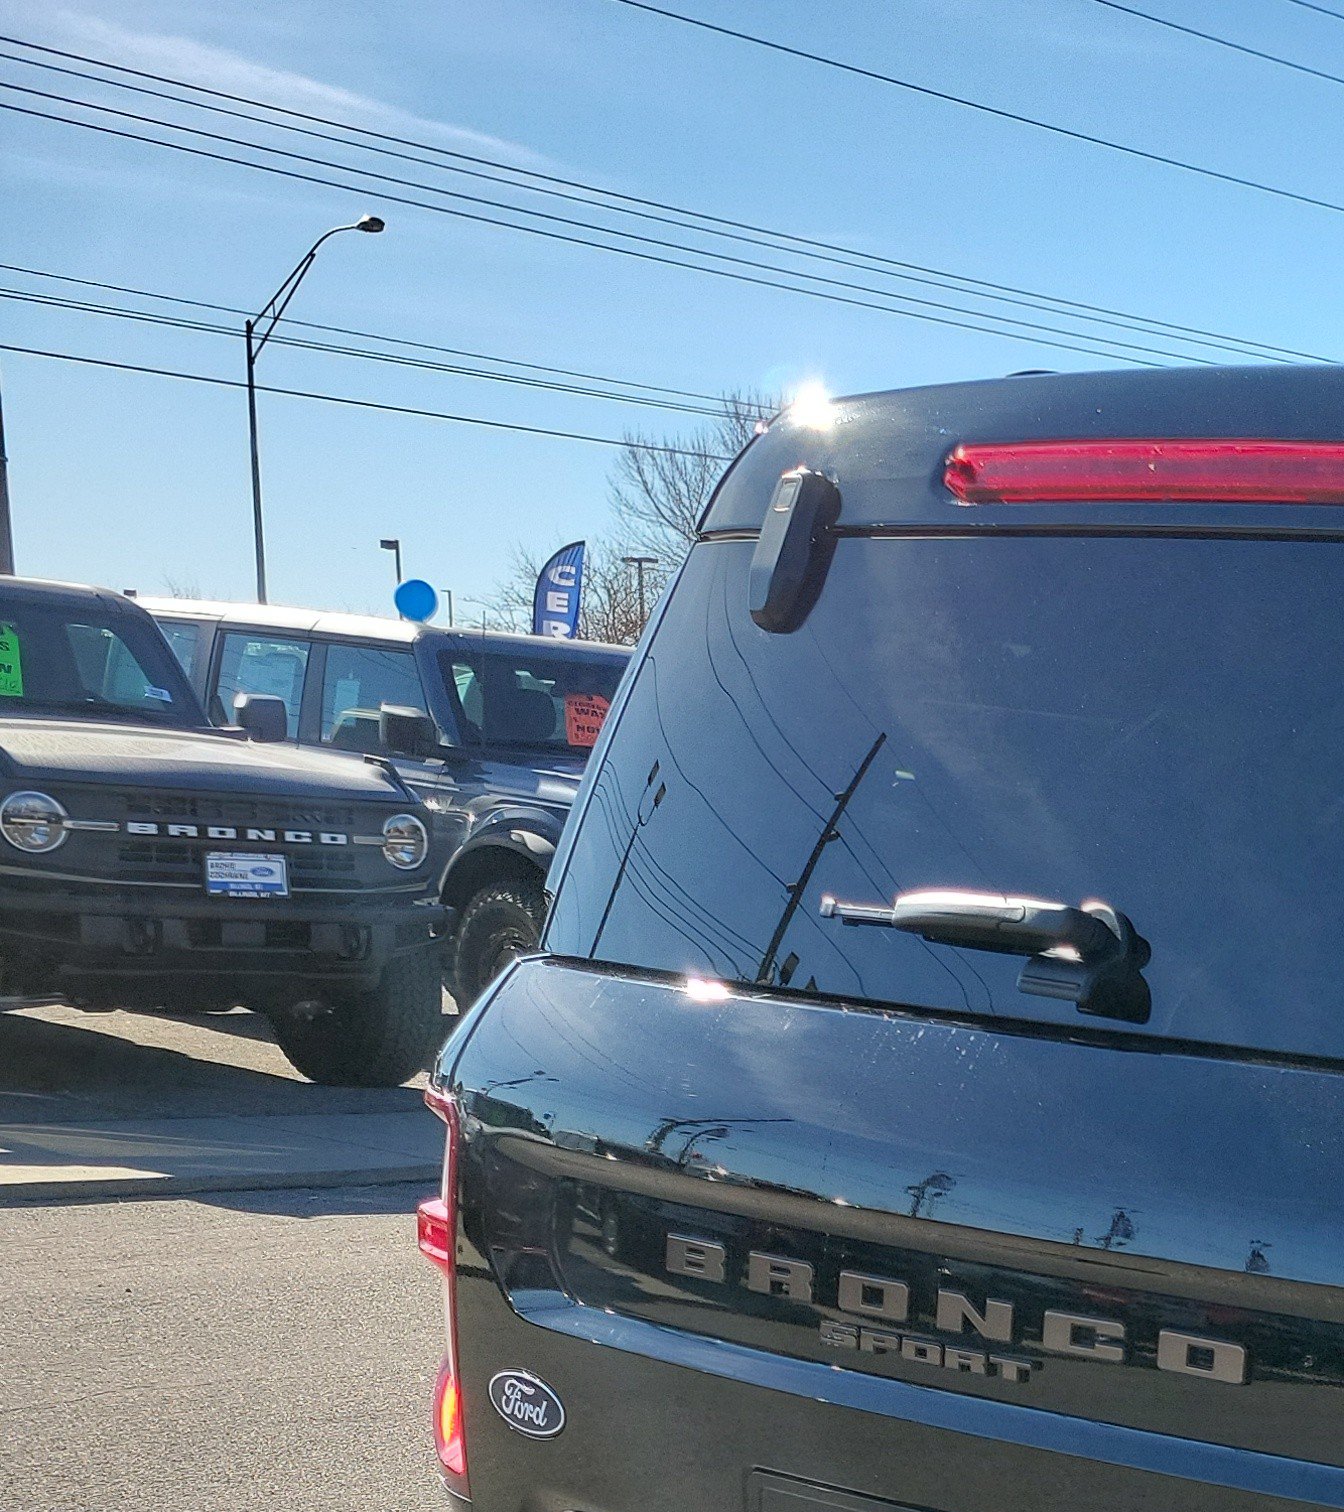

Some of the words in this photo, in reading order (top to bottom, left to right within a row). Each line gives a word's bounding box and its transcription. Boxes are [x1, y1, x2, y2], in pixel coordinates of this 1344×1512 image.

[126, 821, 348, 845] BRONCO
[666, 1232, 1250, 1385] BRONCO
[820, 1320, 1043, 1383] SPORT
[502, 1378, 548, 1427] Ford
